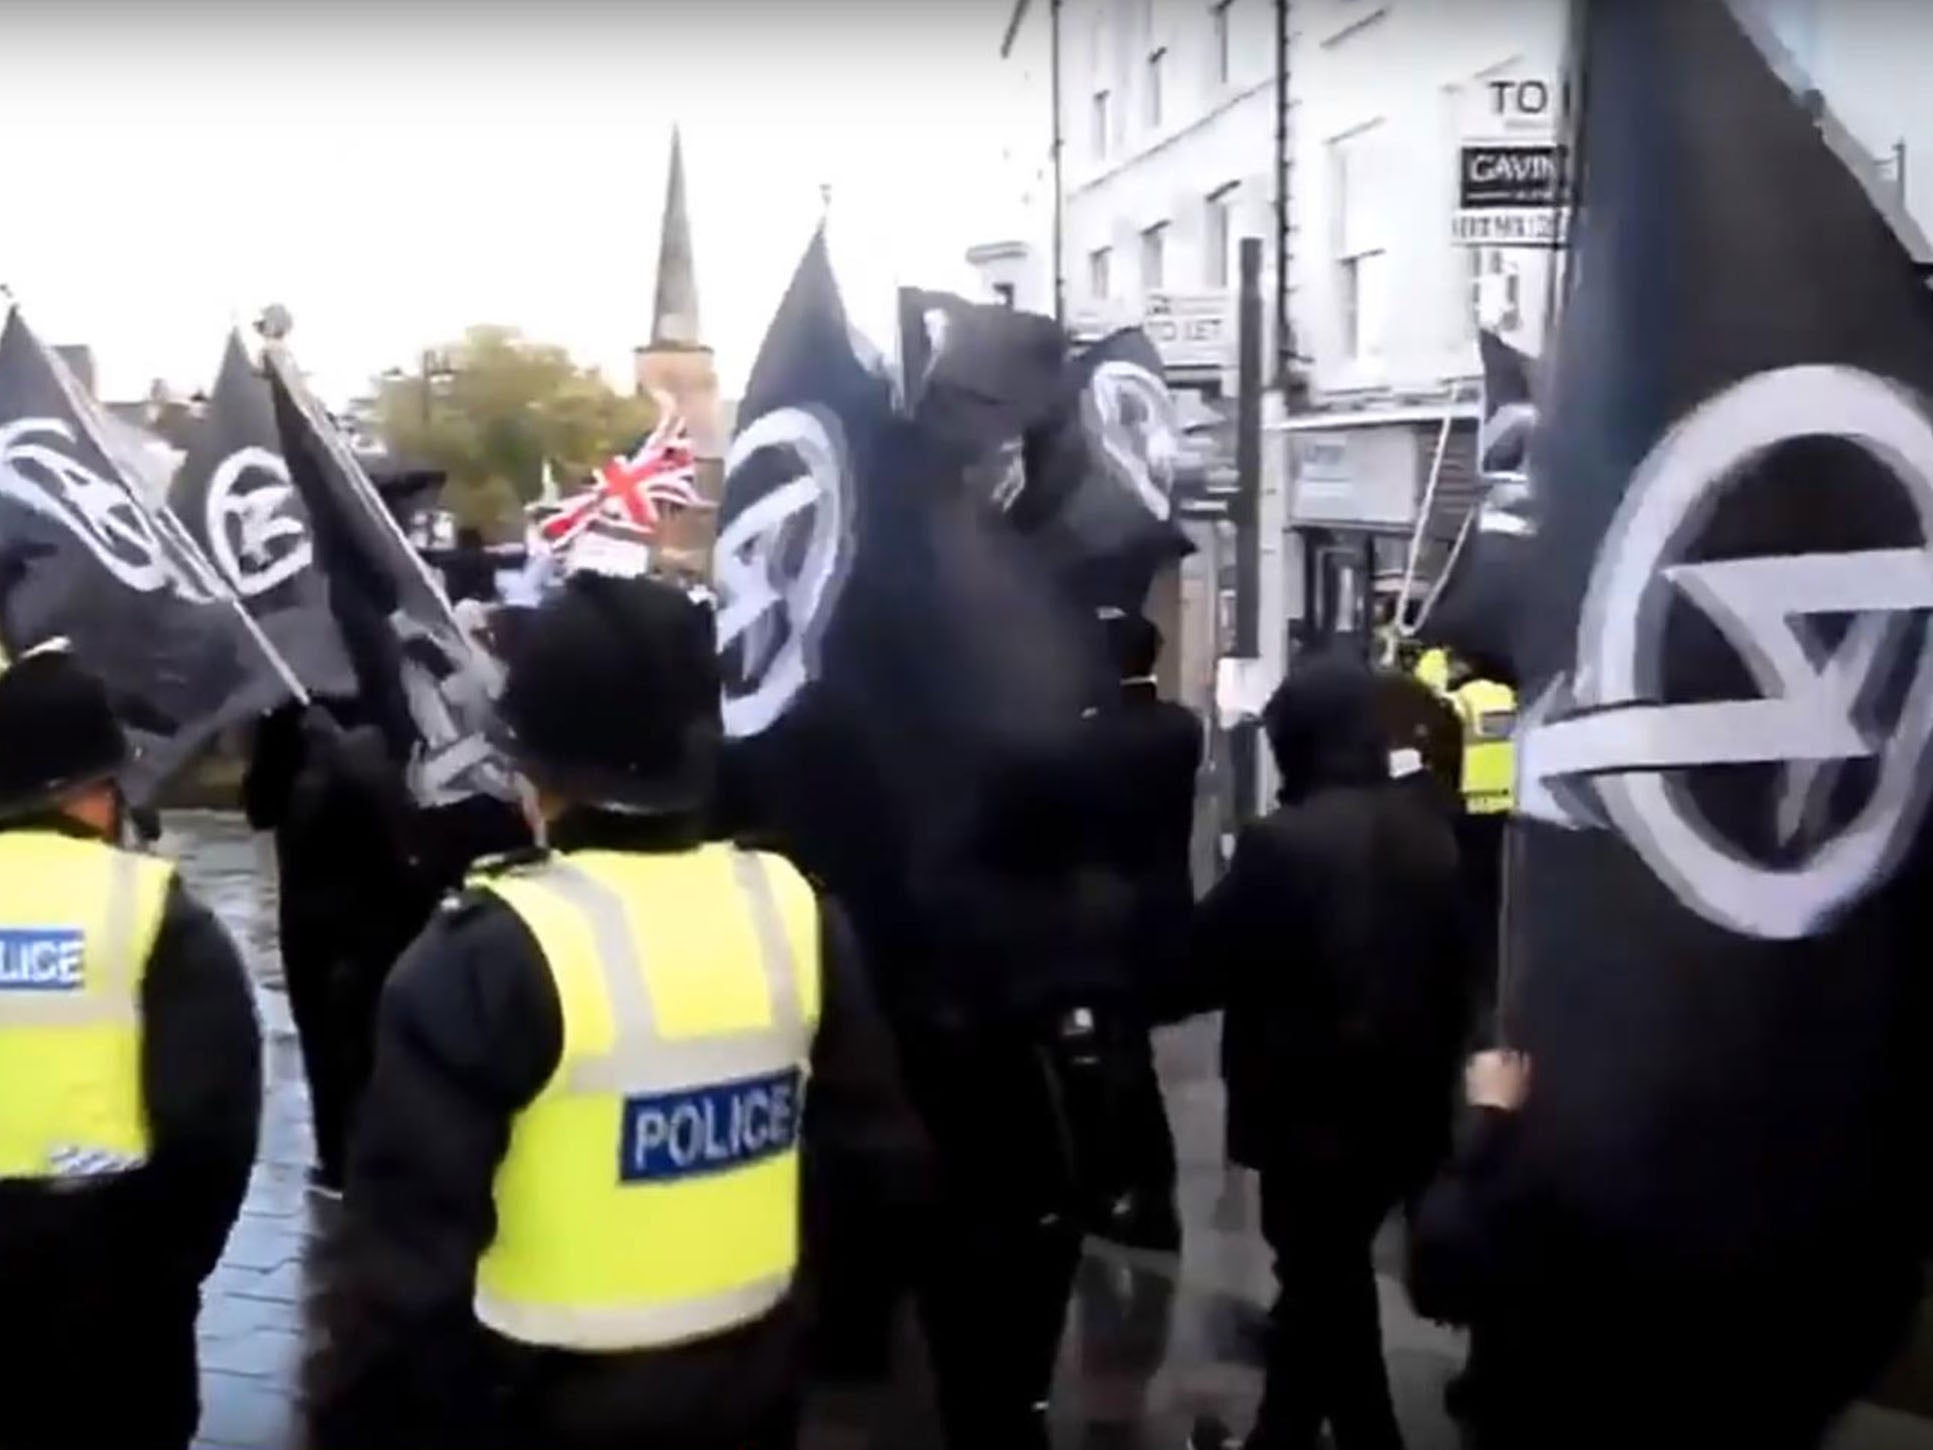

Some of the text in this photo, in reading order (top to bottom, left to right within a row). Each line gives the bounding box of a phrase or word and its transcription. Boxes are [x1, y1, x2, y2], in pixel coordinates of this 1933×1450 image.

[1488, 80, 1548, 115] TO
[0, 940, 84, 982] LICE
[634, 1084, 792, 1171] POLICE
